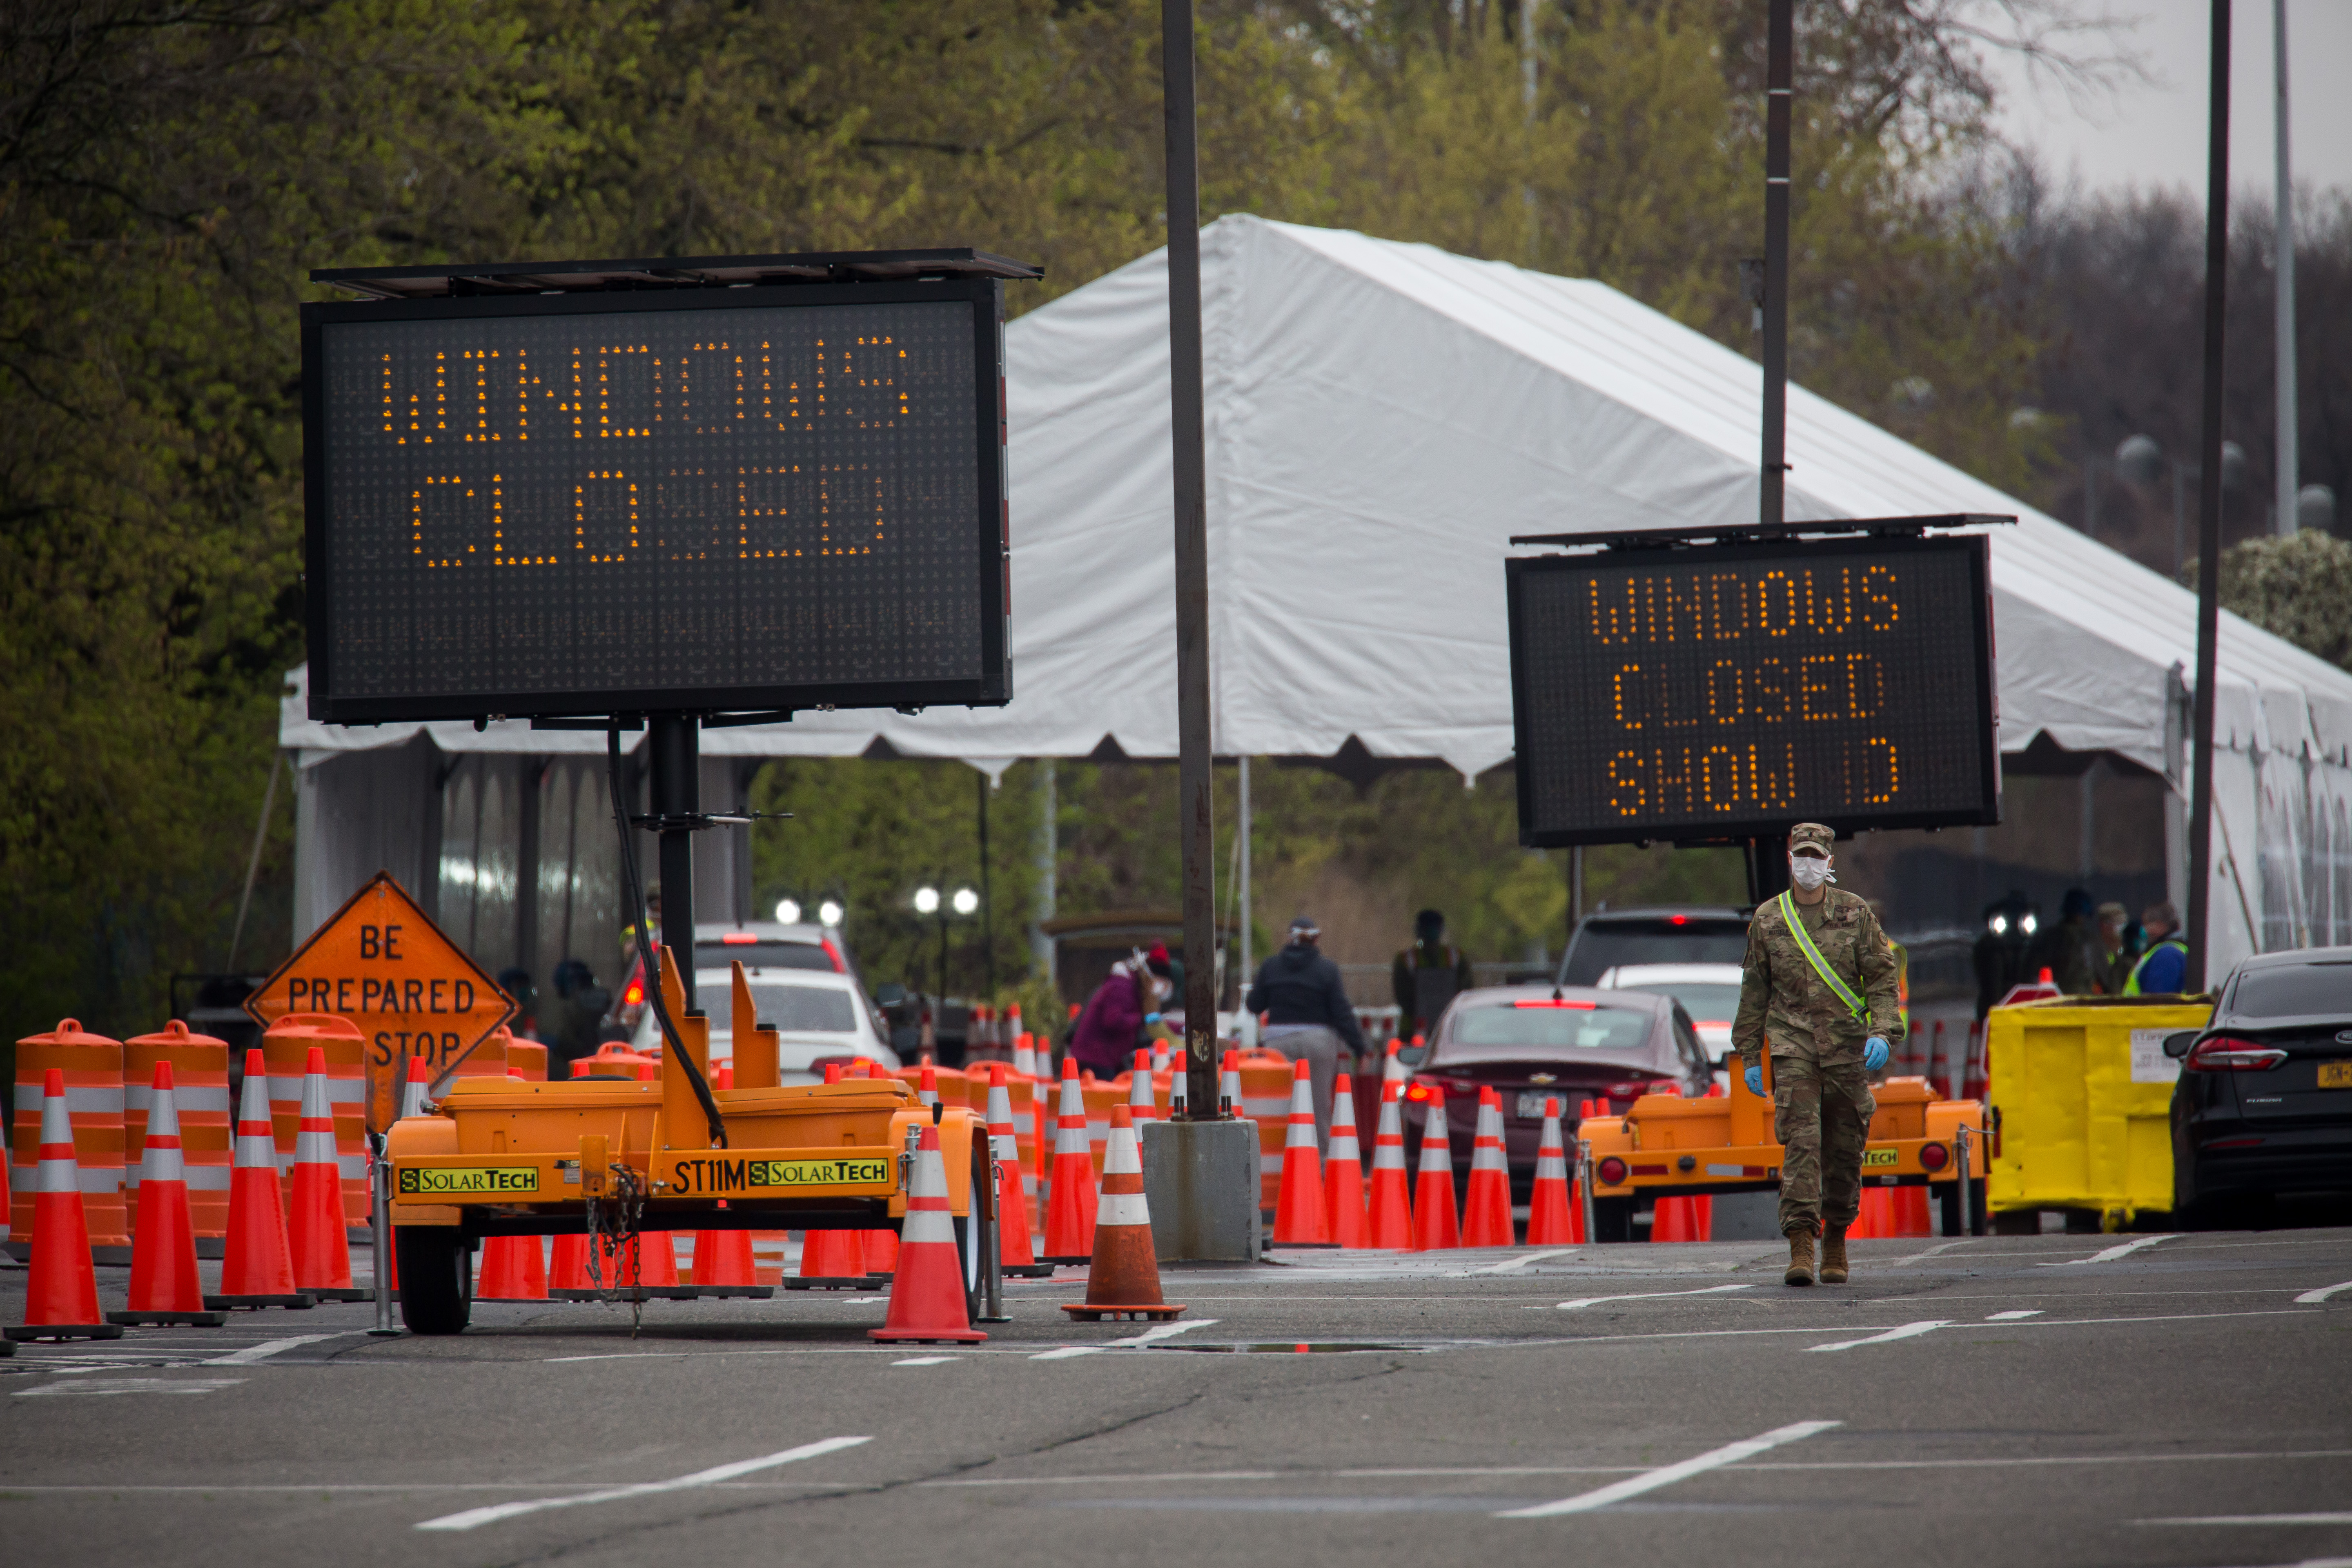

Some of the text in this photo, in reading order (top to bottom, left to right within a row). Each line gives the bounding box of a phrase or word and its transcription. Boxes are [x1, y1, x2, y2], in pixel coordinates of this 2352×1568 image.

[382, 336, 909, 444] WINDOWS
[412, 465, 884, 568] CLOSED
[1590, 566, 1899, 644] WINDOWS
[1614, 653, 1883, 730] CLOSED
[1609, 737, 1899, 816] SHOW ID
[360, 925, 402, 960] BE
[289, 978, 474, 1013] PREPARED
[373, 1031, 461, 1067] STOP
